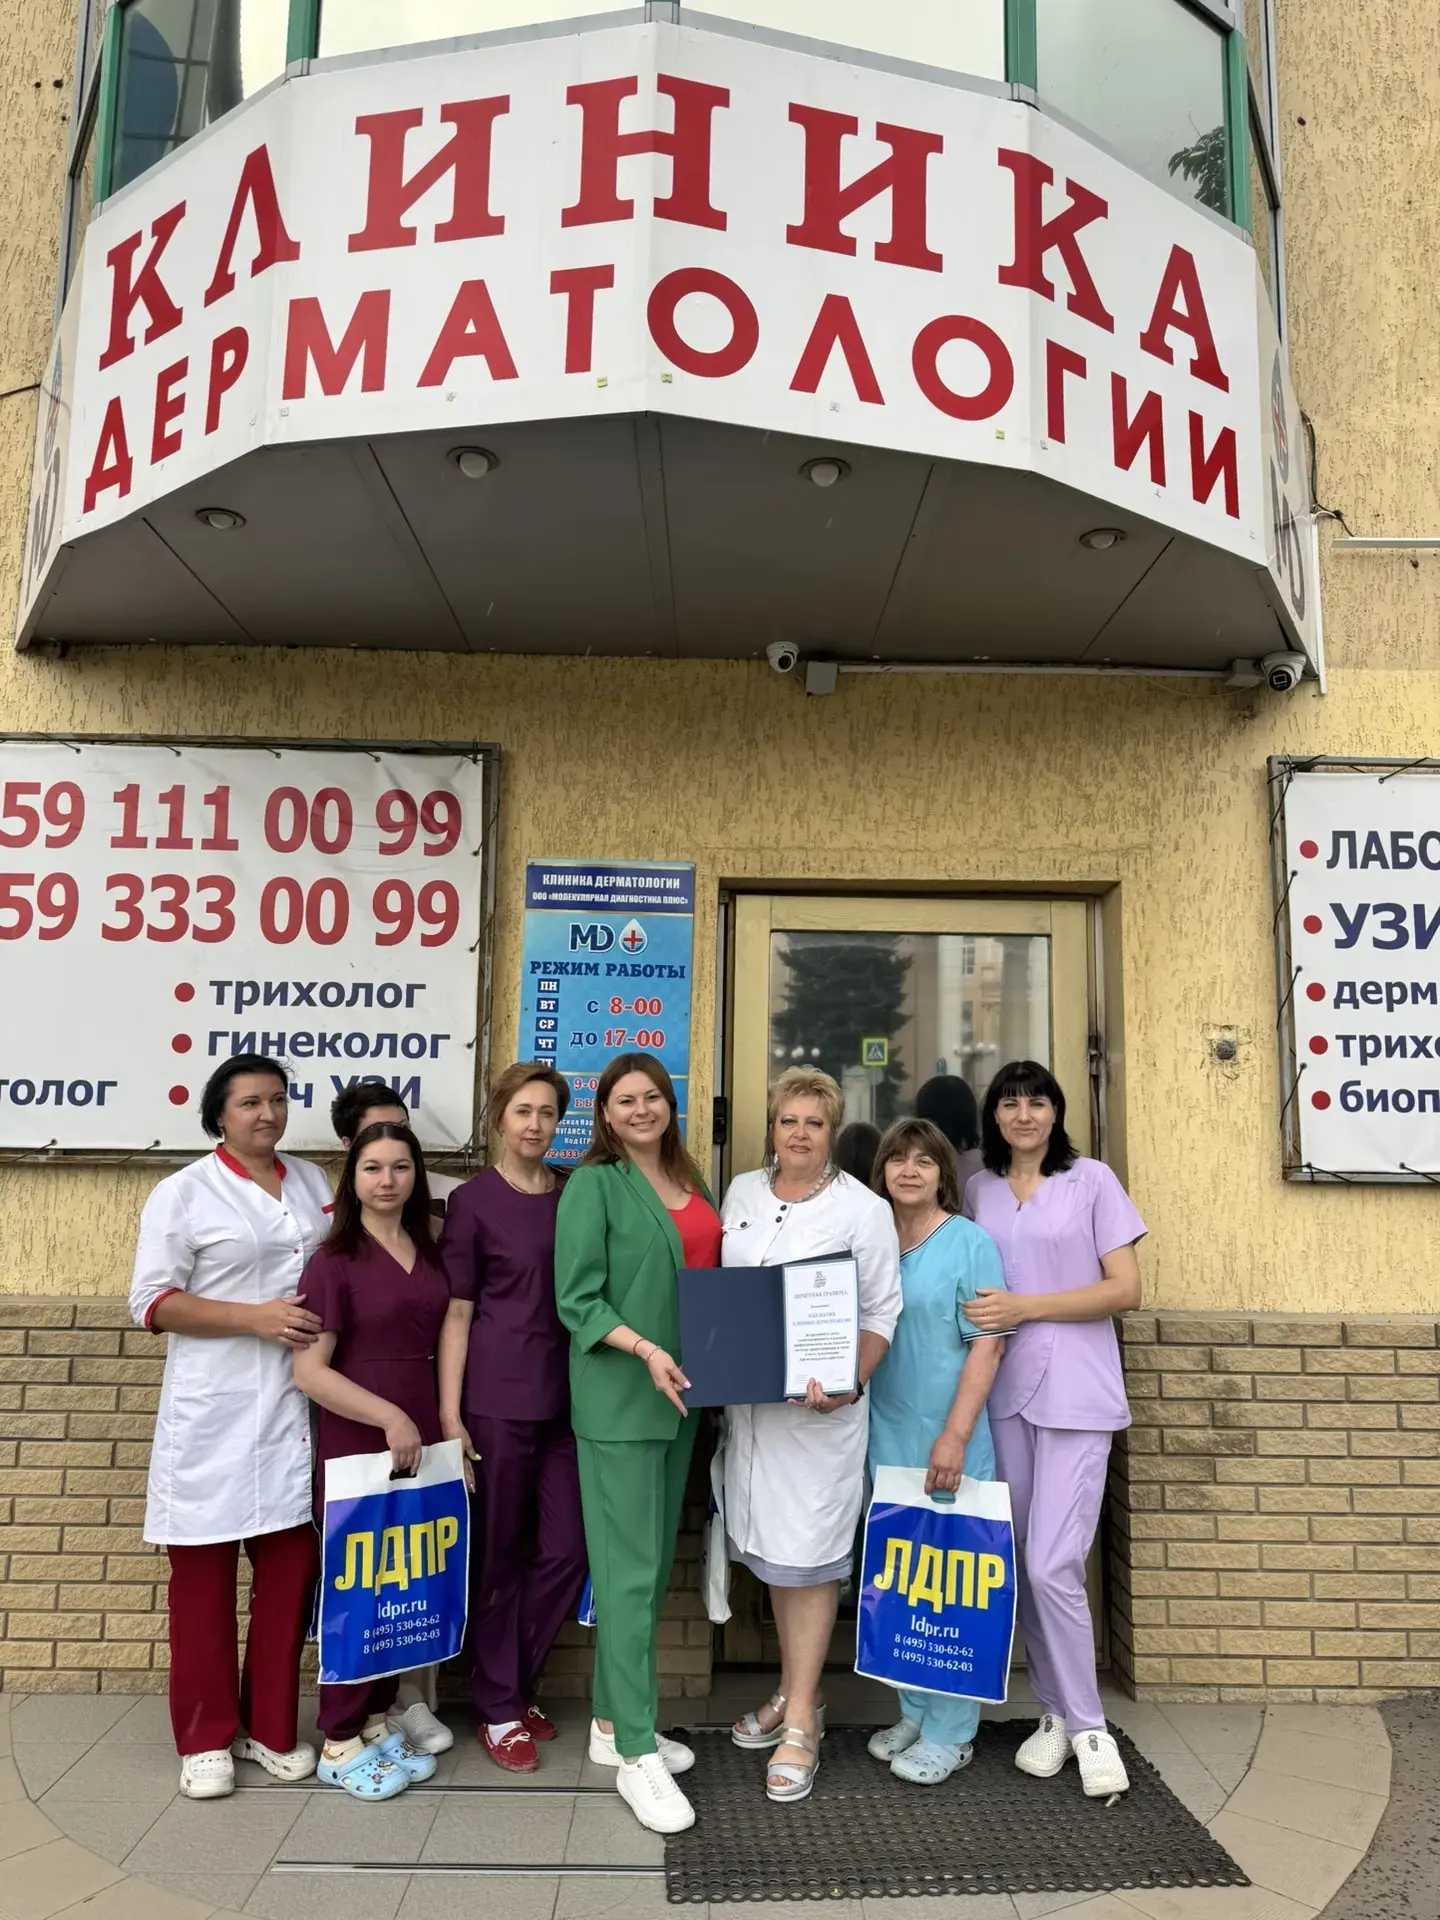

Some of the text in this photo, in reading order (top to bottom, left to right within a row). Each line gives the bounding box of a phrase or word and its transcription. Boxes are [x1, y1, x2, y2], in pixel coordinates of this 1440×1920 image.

[99, 73, 1229, 393] КЛИНИКА
[82, 264, 1240, 519] ДЕРМАТОЛОГИИ
[110, 784, 239, 852] 111
[264, 786, 353, 856] 00
[375, 789, 462, 857] 99
[543, 874, 680, 889] КЛИНИКА ДЕРМАТОЛОГИИ
[101, 873, 236, 943] 333
[260, 877, 349, 945] 00
[372, 878, 459, 947] 99
[532, 892, 547, 900] ООО
[610, 895, 661, 904] ДИАГНОСТИКА
[530, 961, 685, 978] РЕЖИМ РАБОТЫ
[209, 980, 426, 1014] трихолог
[540, 981, 558, 991] ПН
[540, 1000, 556, 1010] ВТ
[609, 996, 663, 1016] 8-00
[538, 1019, 555, 1029] СР
[207, 1031, 451, 1059] гинеколог
[538, 1039, 554, 1049] ЧТ
[604, 1028, 665, 1048] 17-00
[334, 1516, 458, 1596] ЛДПР
[873, 1537, 1005, 1614] ЛДПР
[377, 1599, 427, 1620] ldpr.ru
[363, 1614, 440, 1639] 8 (495) 530-62-62
[911, 1614, 959, 1638] ldpr.ru
[363, 1629, 440, 1654] 8 (495) 530-62-03
[894, 1633, 974, 1658] 8 (495) 530-62-62
[893, 1648, 973, 1672] 8 (495) 530-62-03
